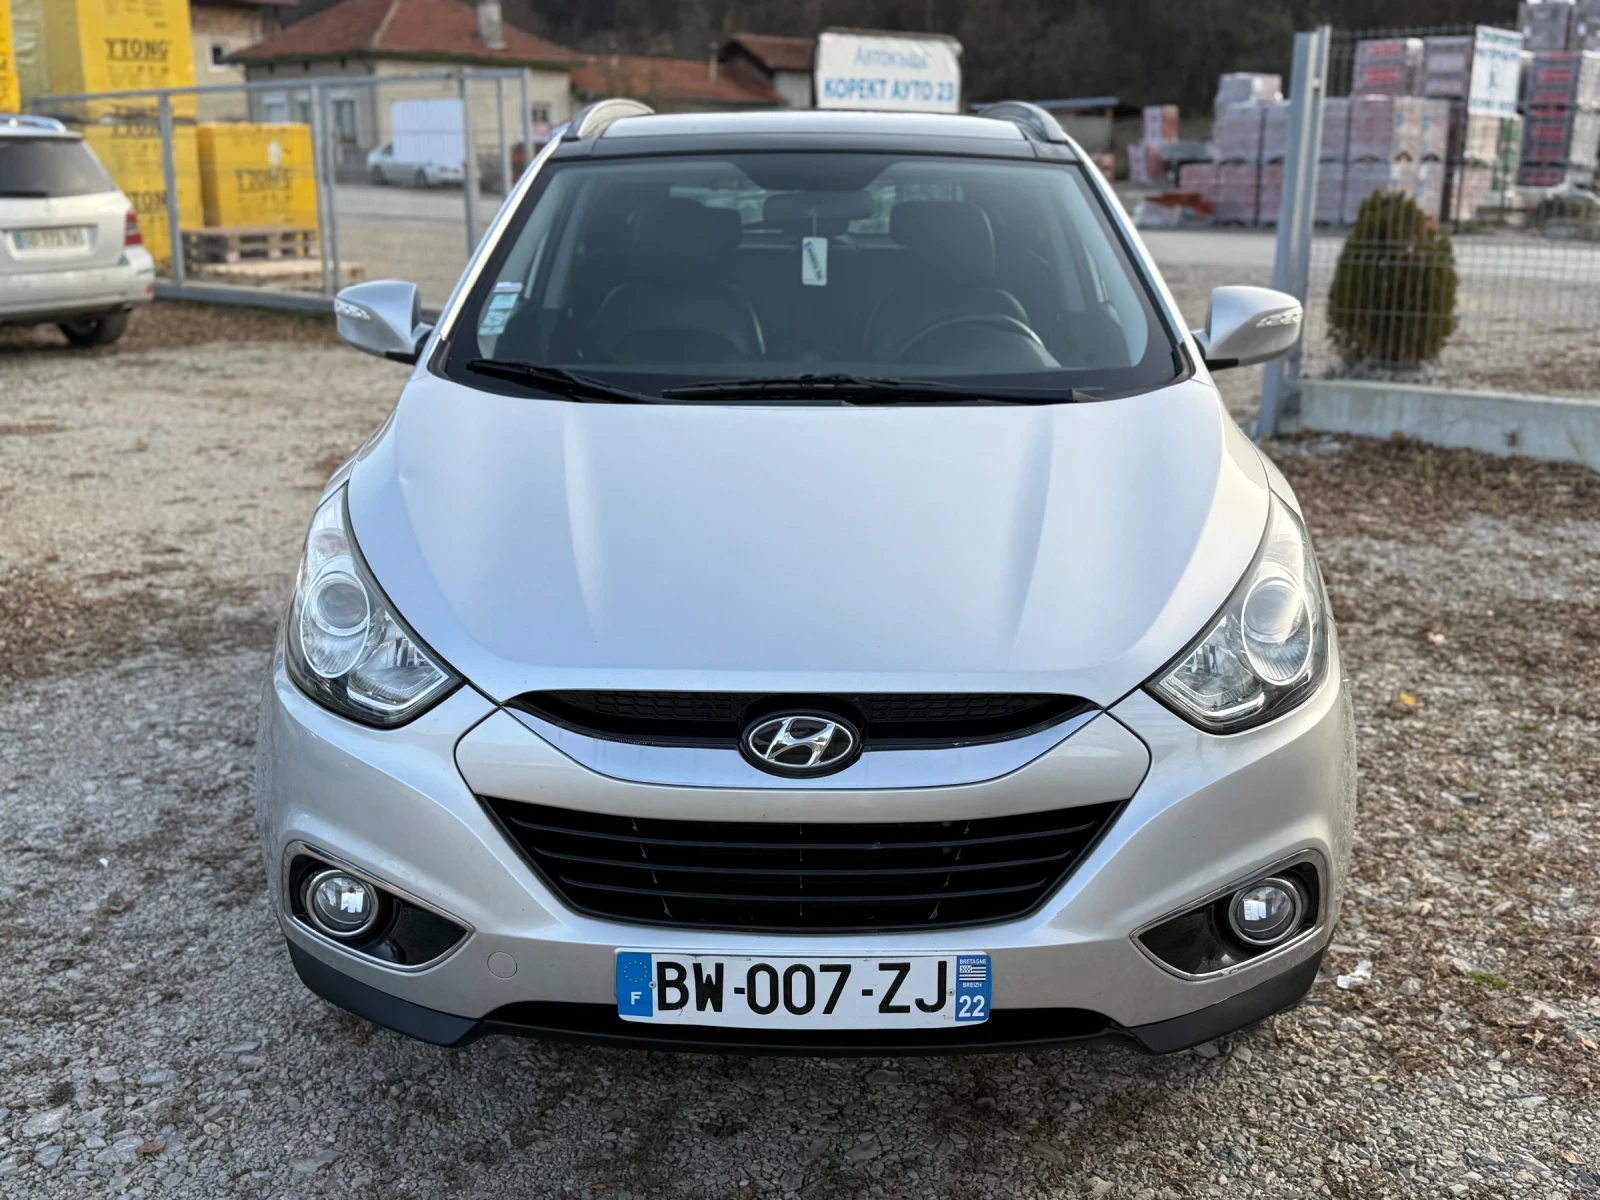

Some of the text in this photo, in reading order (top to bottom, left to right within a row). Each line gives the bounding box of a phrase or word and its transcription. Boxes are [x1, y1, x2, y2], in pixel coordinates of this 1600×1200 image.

[824, 77, 889, 99] КОРЕКТ
[937, 81, 956, 102] 23
[630, 991, 642, 1005] F
[656, 960, 948, 1016] BW-007-ZJ
[958, 995, 986, 1018] 22
